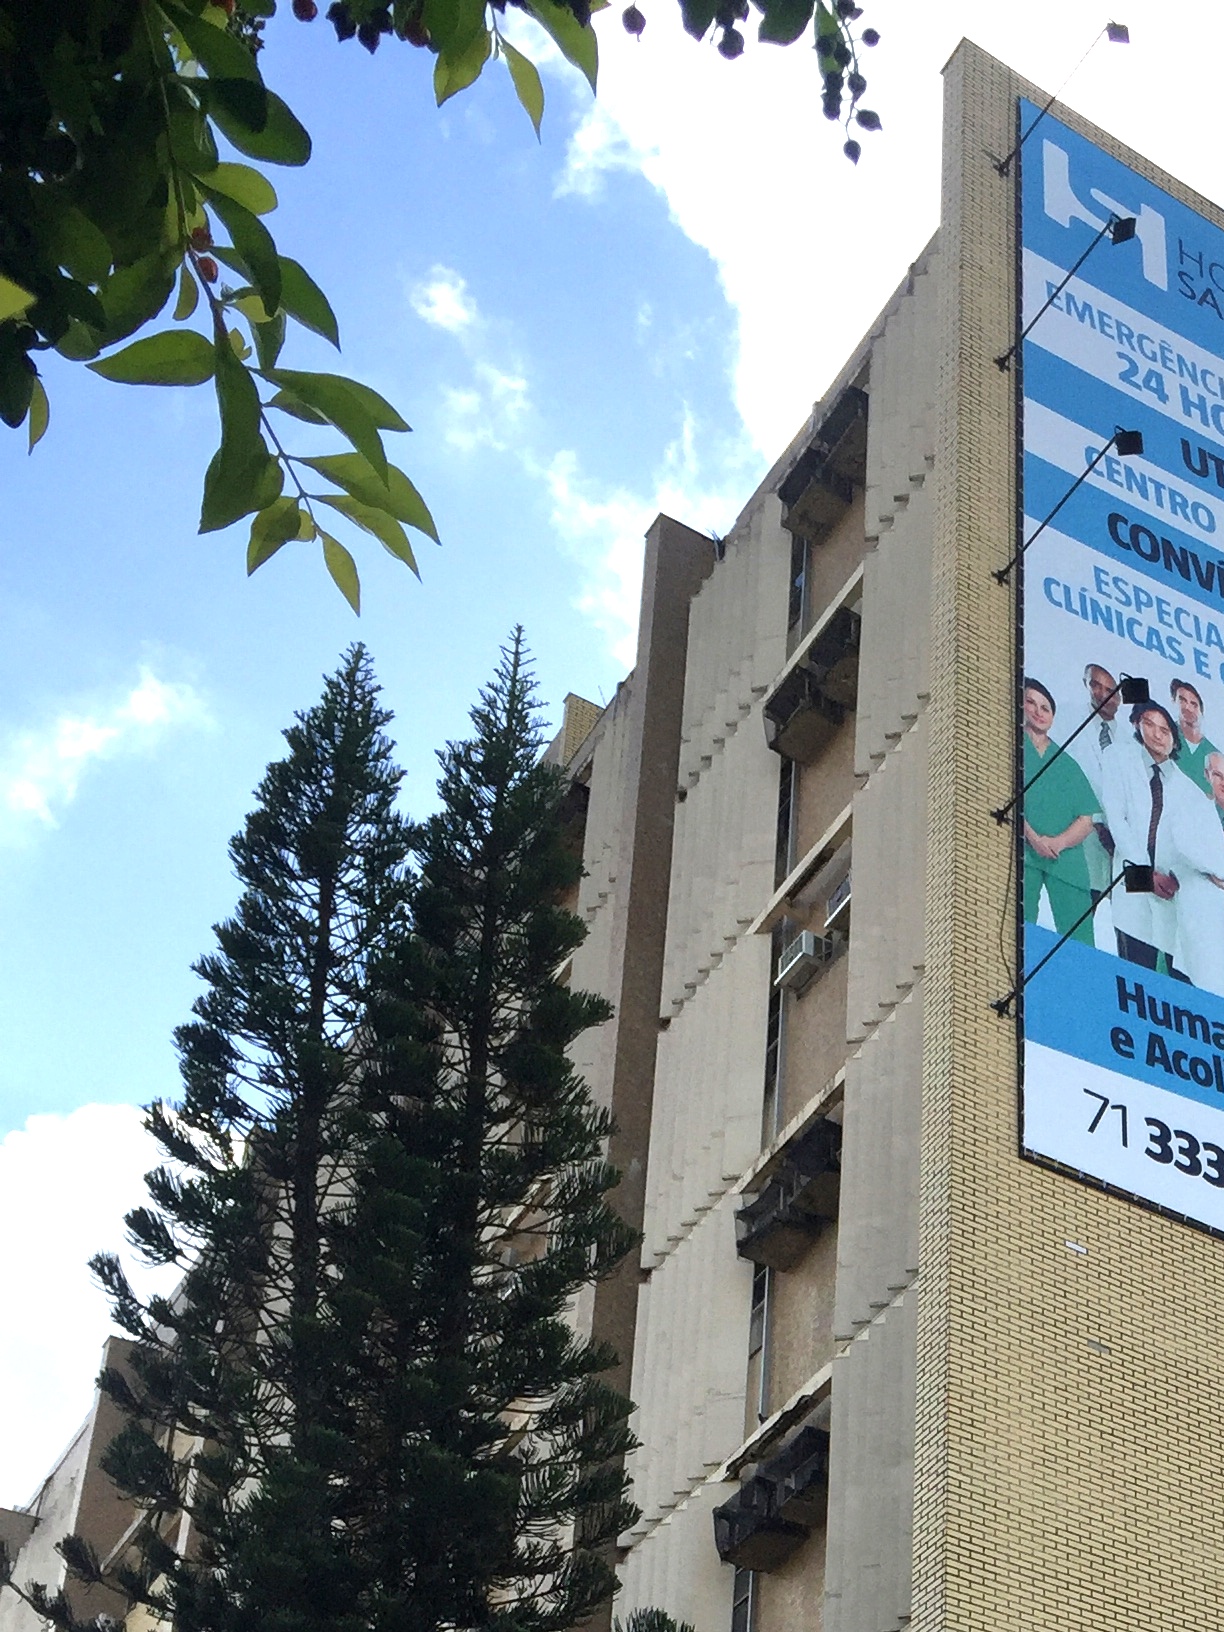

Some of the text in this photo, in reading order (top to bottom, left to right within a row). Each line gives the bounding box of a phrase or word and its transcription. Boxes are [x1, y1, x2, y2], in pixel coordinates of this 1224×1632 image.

[1117, 354, 1168, 405] 24
[1084, 446, 1216, 534] CENTRO
[1043, 576, 1185, 666] CLÍNICAS
[1194, 646, 1212, 680] E
[1110, 1026, 1134, 1060] e
[1083, 1087, 1129, 1148] 71
